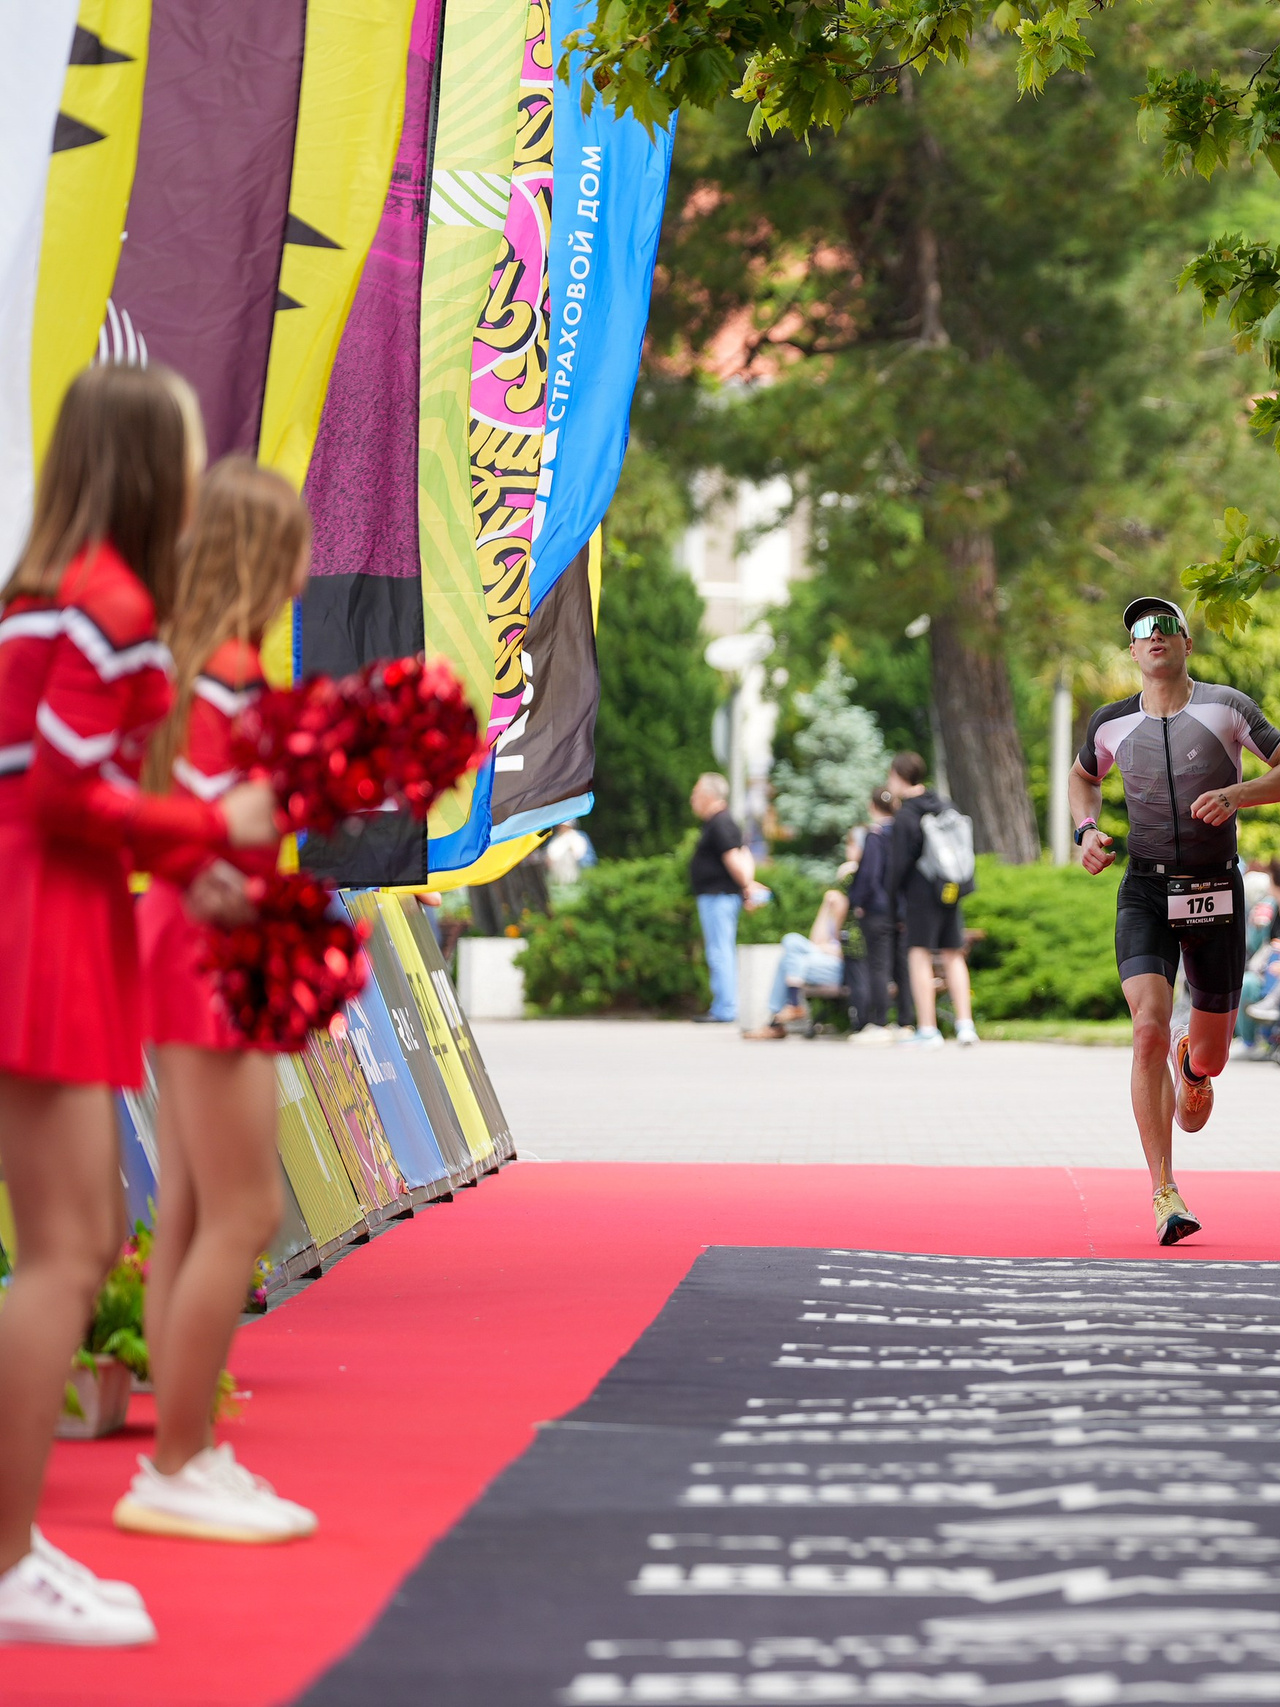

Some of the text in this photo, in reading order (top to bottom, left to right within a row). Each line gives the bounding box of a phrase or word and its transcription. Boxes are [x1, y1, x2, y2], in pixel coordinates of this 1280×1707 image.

[547, 230, 594, 422] СТРАХОВОЙ
[577, 146, 602, 223] ДОМ
[1218, 793, 1231, 808] 176
[1186, 896, 1215, 914] 176
